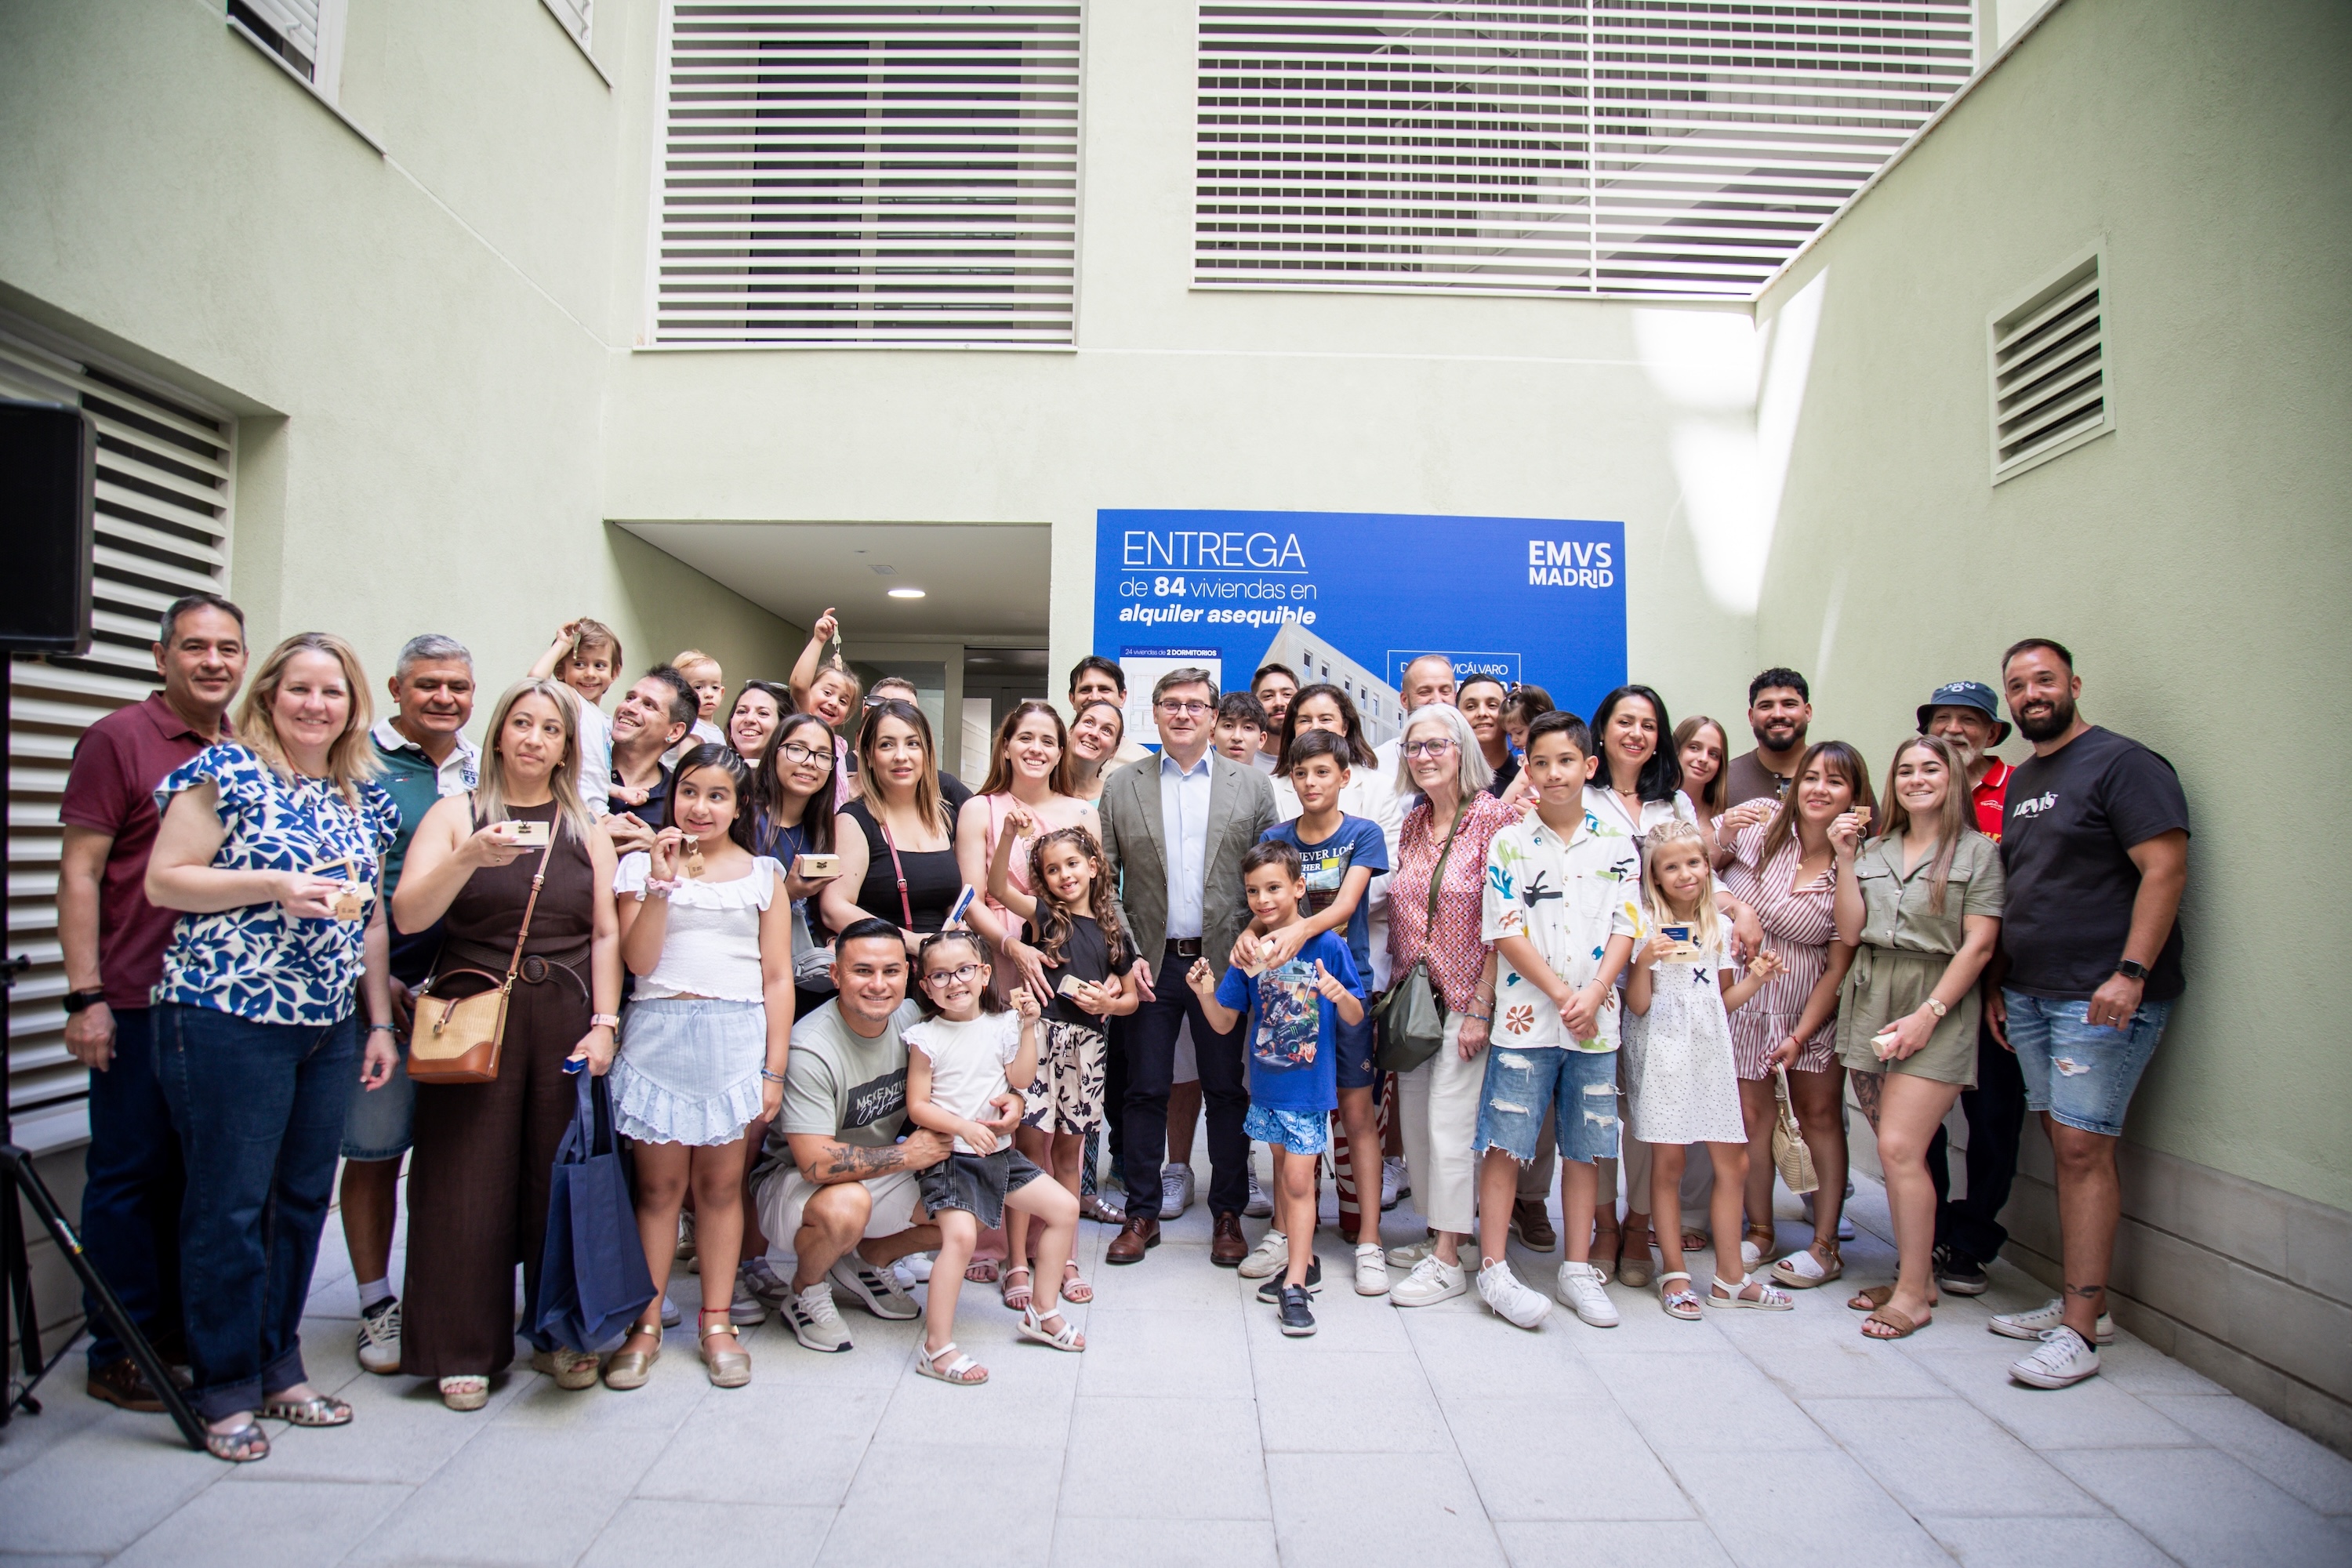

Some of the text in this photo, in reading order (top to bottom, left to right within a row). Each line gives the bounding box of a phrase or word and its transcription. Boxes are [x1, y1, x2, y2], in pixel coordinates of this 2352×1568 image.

[1123, 531, 1306, 568] ENTREGA
[1529, 540, 1612, 568] EMVS
[1119, 576, 1317, 600] de 84 viviendas en
[1529, 567, 1613, 589] MADRID
[1119, 603, 1316, 628] alquiler asequible
